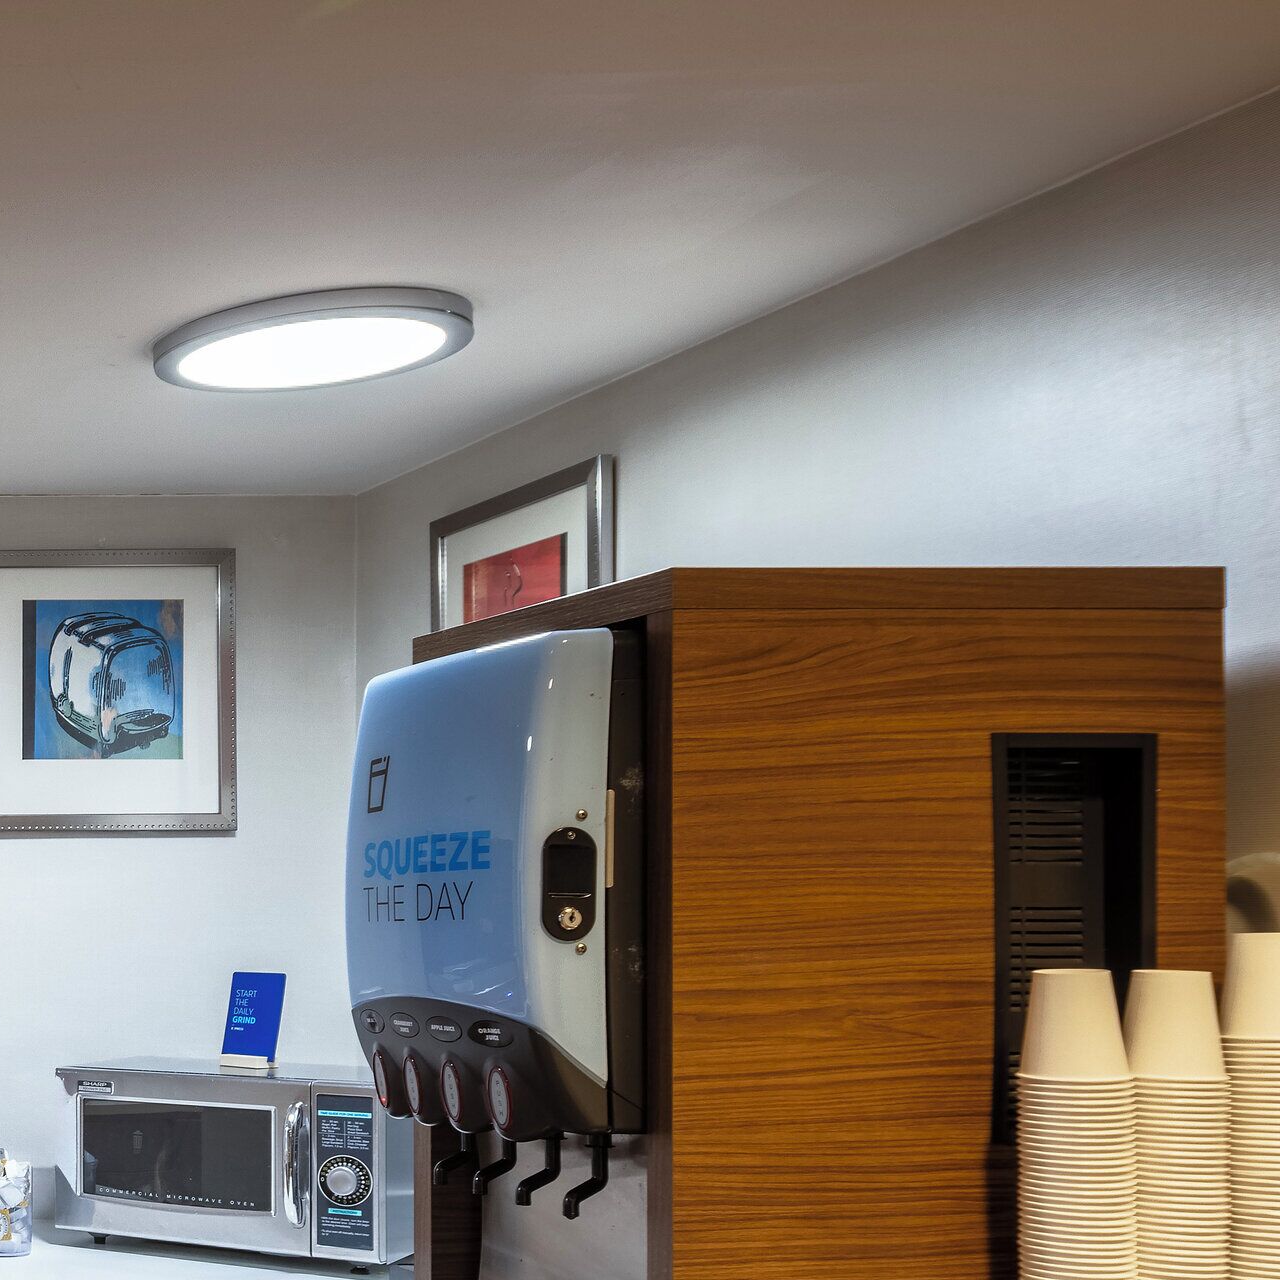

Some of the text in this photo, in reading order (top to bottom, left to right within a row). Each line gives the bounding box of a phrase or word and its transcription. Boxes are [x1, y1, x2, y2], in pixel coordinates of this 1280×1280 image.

[363, 830, 492, 880] SQUEEZE
[363, 881, 473, 922] THE DAY
[235, 989, 258, 998] START
[235, 998, 249, 1006] THE
[233, 1007, 254, 1015] DAILY
[232, 1016, 256, 1024] GRIND
[99, 1187, 159, 1198] COMMERCIAL
[166, 1194, 222, 1204] MICROWAVE
